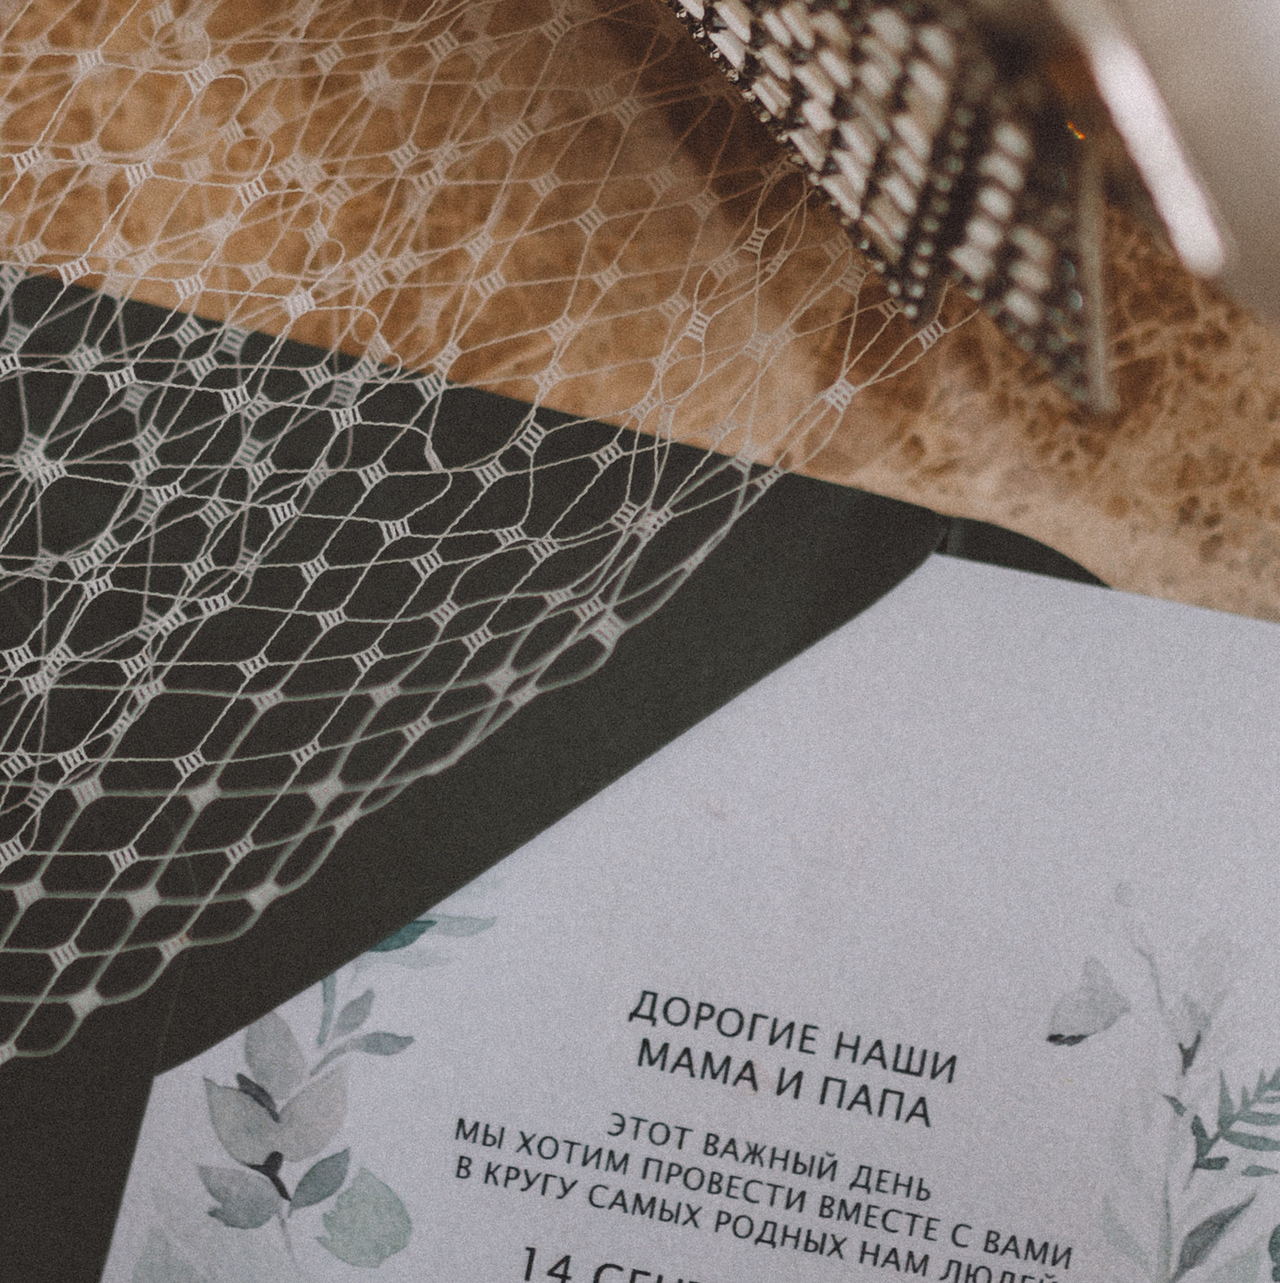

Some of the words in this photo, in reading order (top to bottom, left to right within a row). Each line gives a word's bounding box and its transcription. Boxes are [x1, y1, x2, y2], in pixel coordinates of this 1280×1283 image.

[627, 989, 819, 1056] ДОРОГИЕ
[833, 1030, 958, 1085] НАШИ
[636, 1037, 760, 1093] МАМА
[775, 1066, 805, 1101] И
[817, 1074, 932, 1128] ПАПА
[453, 1116, 506, 1150] МЫ
[515, 1130, 631, 1175] ХОТИМ
[641, 1156, 807, 1213] ПРОВЕСТИ
[818, 1194, 940, 1242] ВМЕСТЕ
[949, 1222, 972, 1249] С
[982, 1228, 1074, 1270] ВАМИ
[606, 1111, 693, 1151] ЭТОТ
[701, 1131, 839, 1182] ВАЖНЫЙ
[849, 1163, 932, 1203] ДЕНЬ
[454, 1153, 474, 1181] В
[482, 1161, 579, 1201] КРУГУ
[586, 1183, 702, 1229] САМЫХ
[713, 1209, 847, 1260] РОДНЫХ
[858, 1240, 931, 1277] НАМ
